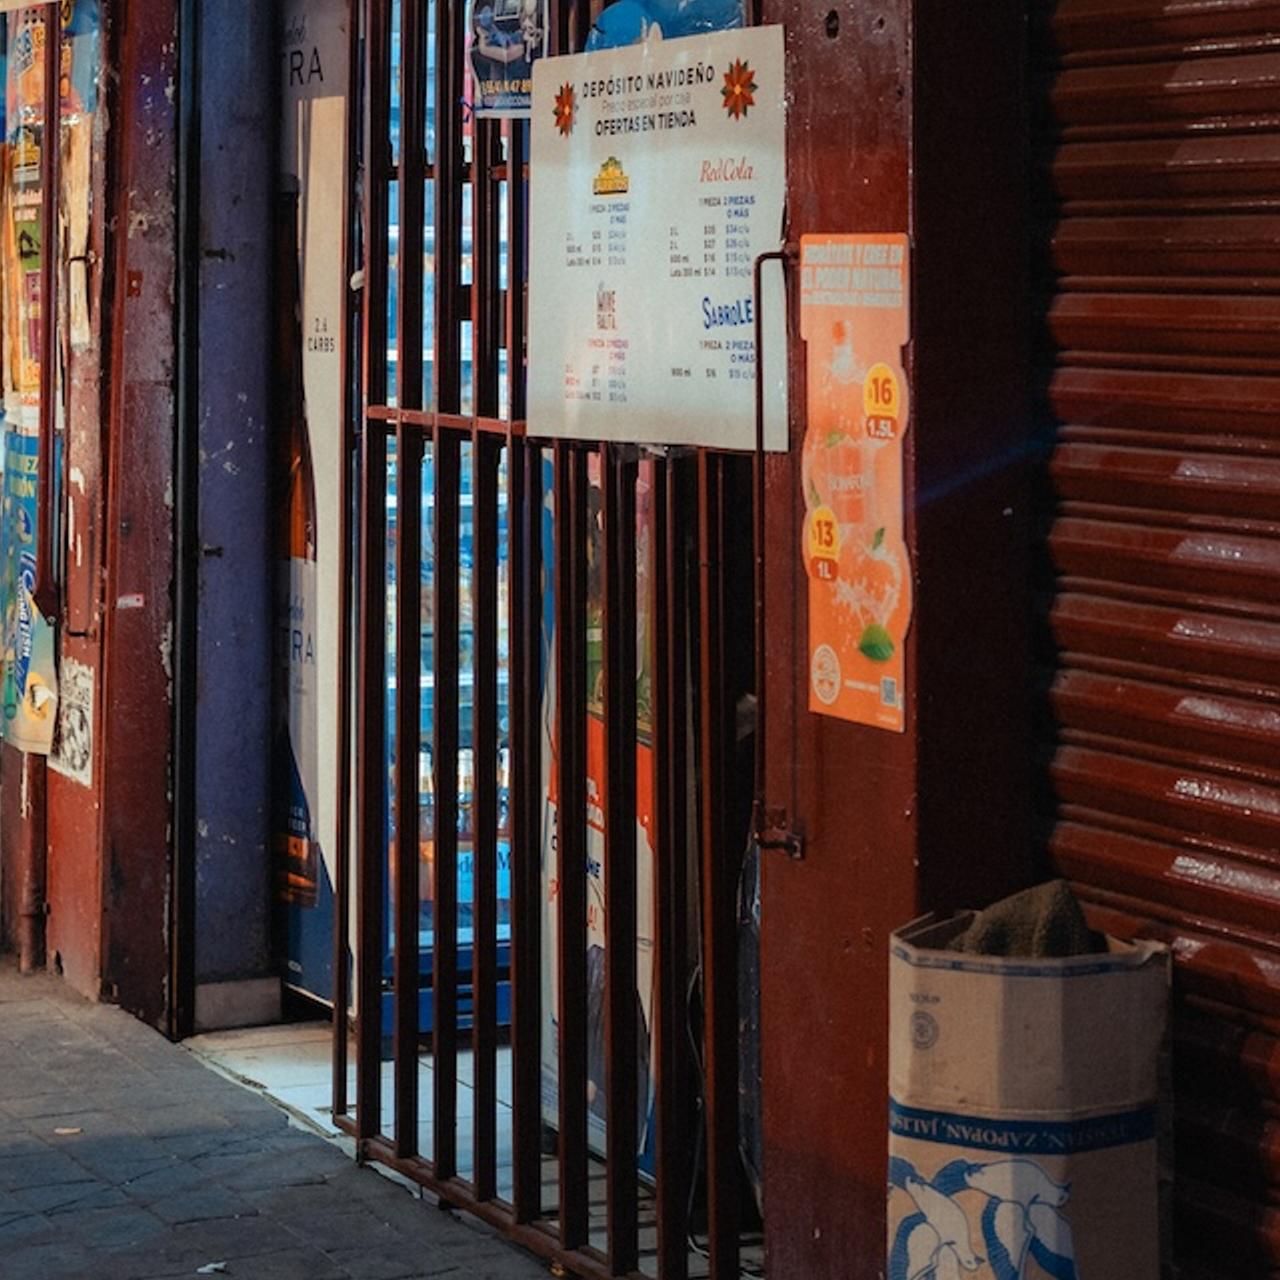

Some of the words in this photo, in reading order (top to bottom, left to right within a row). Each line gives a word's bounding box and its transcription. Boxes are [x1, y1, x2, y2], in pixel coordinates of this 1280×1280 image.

[582, 74, 644, 98] DEPÓSITO
[647, 62, 716, 89] NAVIDEÑO
[595, 116, 640, 136] OFERTAS
[641, 115, 656, 131] EN
[658, 110, 697, 129] TIENDA
[728, 195, 755, 205] PIEZAS
[307, 336, 335, 352] CARBS
[732, 340, 755, 350] PIEZA
[942, 1121, 1037, 1148] ZAPOPAN,
